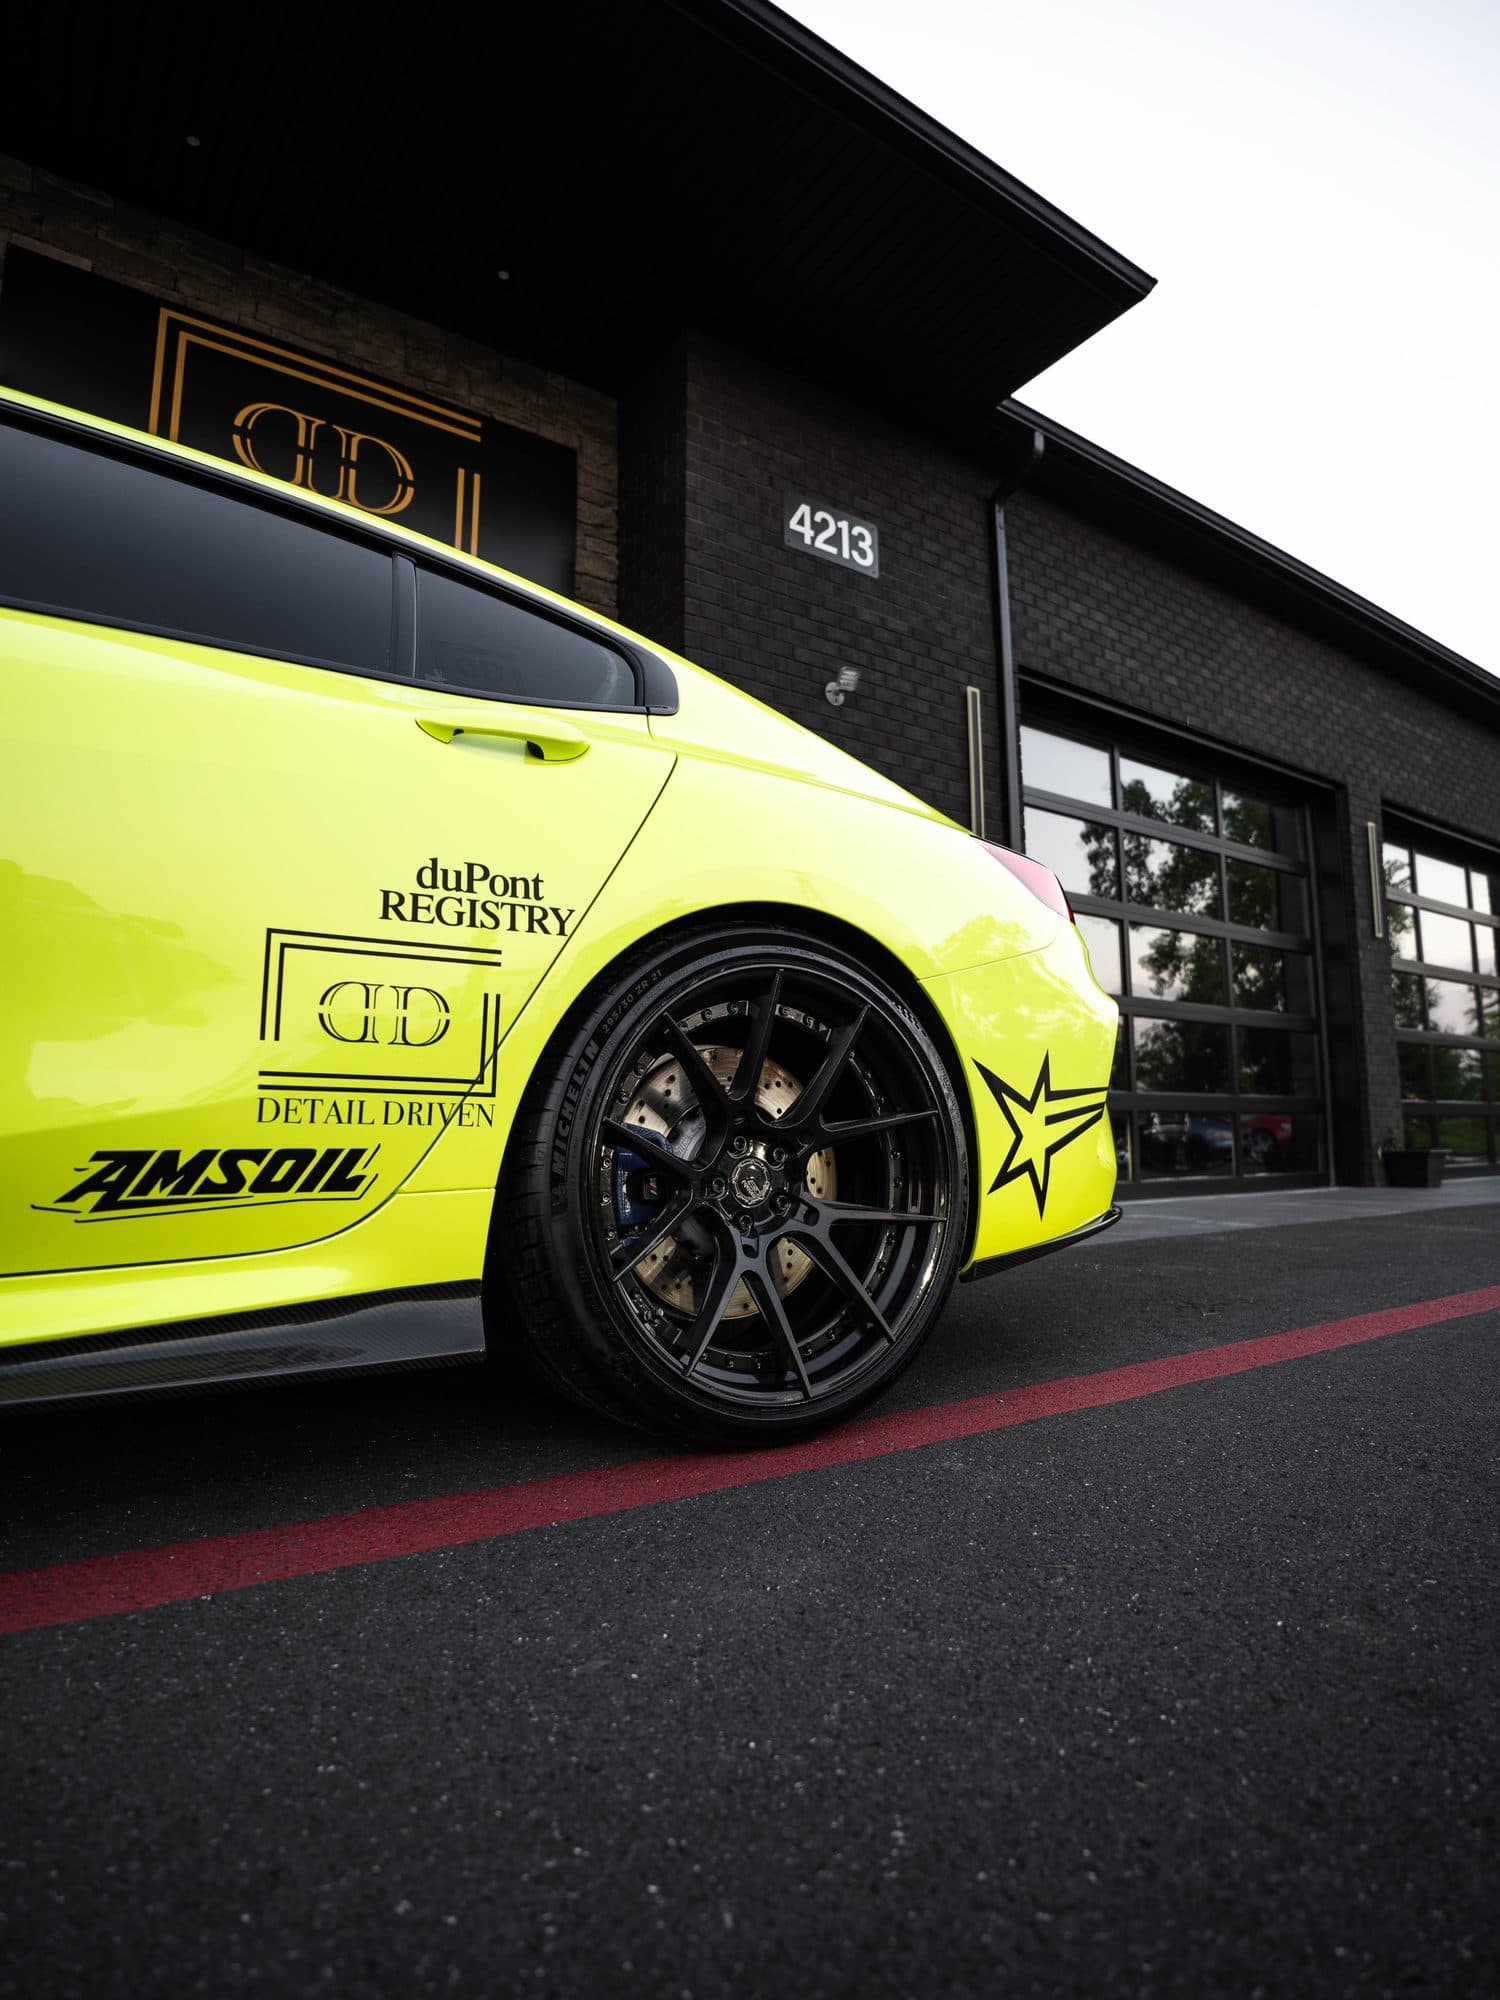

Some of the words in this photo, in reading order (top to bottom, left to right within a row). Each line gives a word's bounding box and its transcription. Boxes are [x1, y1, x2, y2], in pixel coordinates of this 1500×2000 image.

[789, 503, 875, 567] 4213
[417, 857, 544, 902] duPont
[379, 889, 575, 937] REGISTRY
[602, 992, 634, 1034] 295/30
[634, 980, 649, 995] ZR
[650, 969, 662, 981] 21
[257, 1097, 376, 1126] DETAIL
[382, 1101, 495, 1128] DRIVEN
[551, 1037, 601, 1176] MICHELIN
[55, 1148, 368, 1213] AMSOIL
